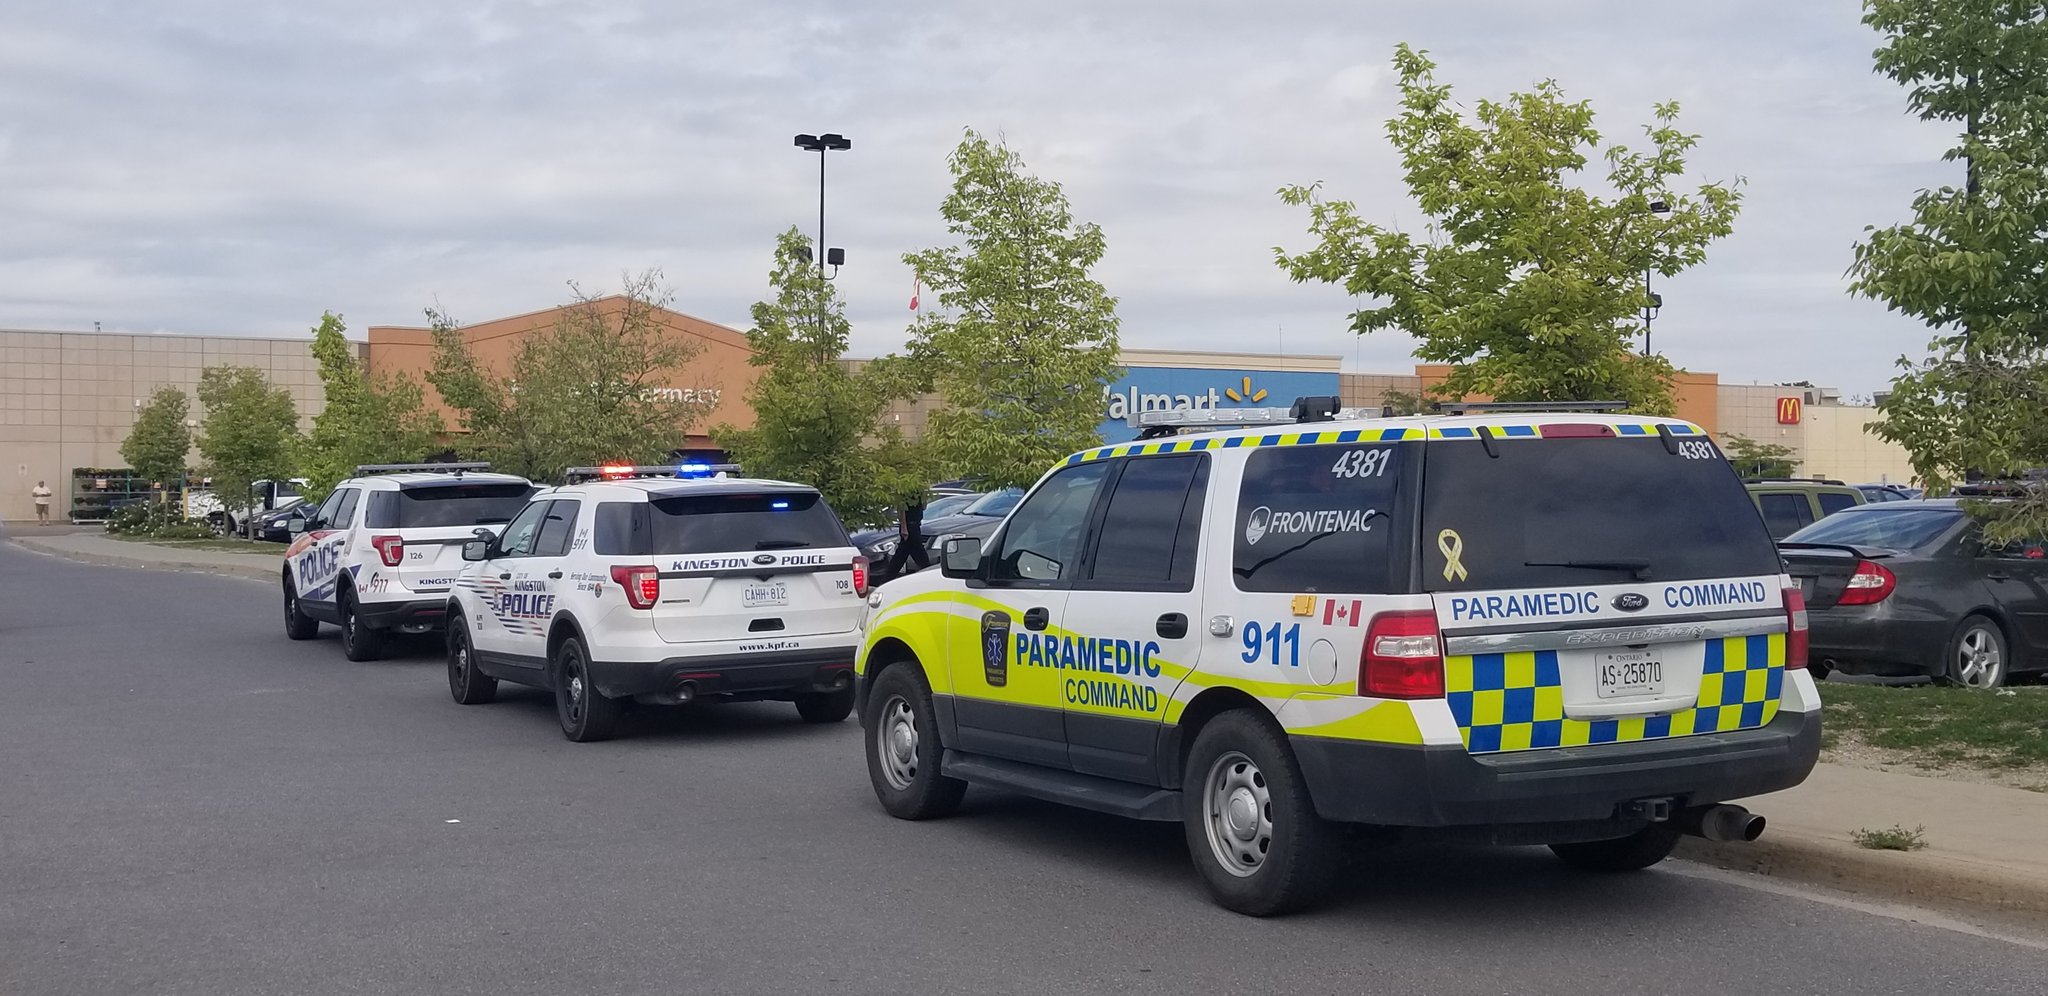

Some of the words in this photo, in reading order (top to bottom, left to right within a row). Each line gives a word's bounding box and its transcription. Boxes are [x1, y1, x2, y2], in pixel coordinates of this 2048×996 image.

[1678, 441, 1718, 460] 4381
[1331, 449, 1392, 478] 4381
[1269, 509, 1376, 533] FRONTENAC
[571, 539, 588, 550] 911
[300, 540, 338, 591] POLICE
[410, 552, 423, 560] 126
[672, 558, 749, 571] KINGSTON
[781, 554, 826, 565] POLICE
[514, 580, 546, 592] KINGSTON
[836, 580, 849, 589] 108
[1621, 595, 1643, 607] Ford
[1664, 582, 1766, 609] COMMAND
[502, 594, 555, 619] POLICE
[1452, 591, 1600, 621] PARAMEDIC
[1241, 620, 1301, 667] 911
[1566, 625, 1705, 645] EXPEDITION
[739, 641, 800, 652] www.kpf.ca
[1016, 633, 1161, 678] PARAMEDIC
[1616, 654, 1643, 663] ONTARIO
[1066, 679, 1158, 712] COMMAND
